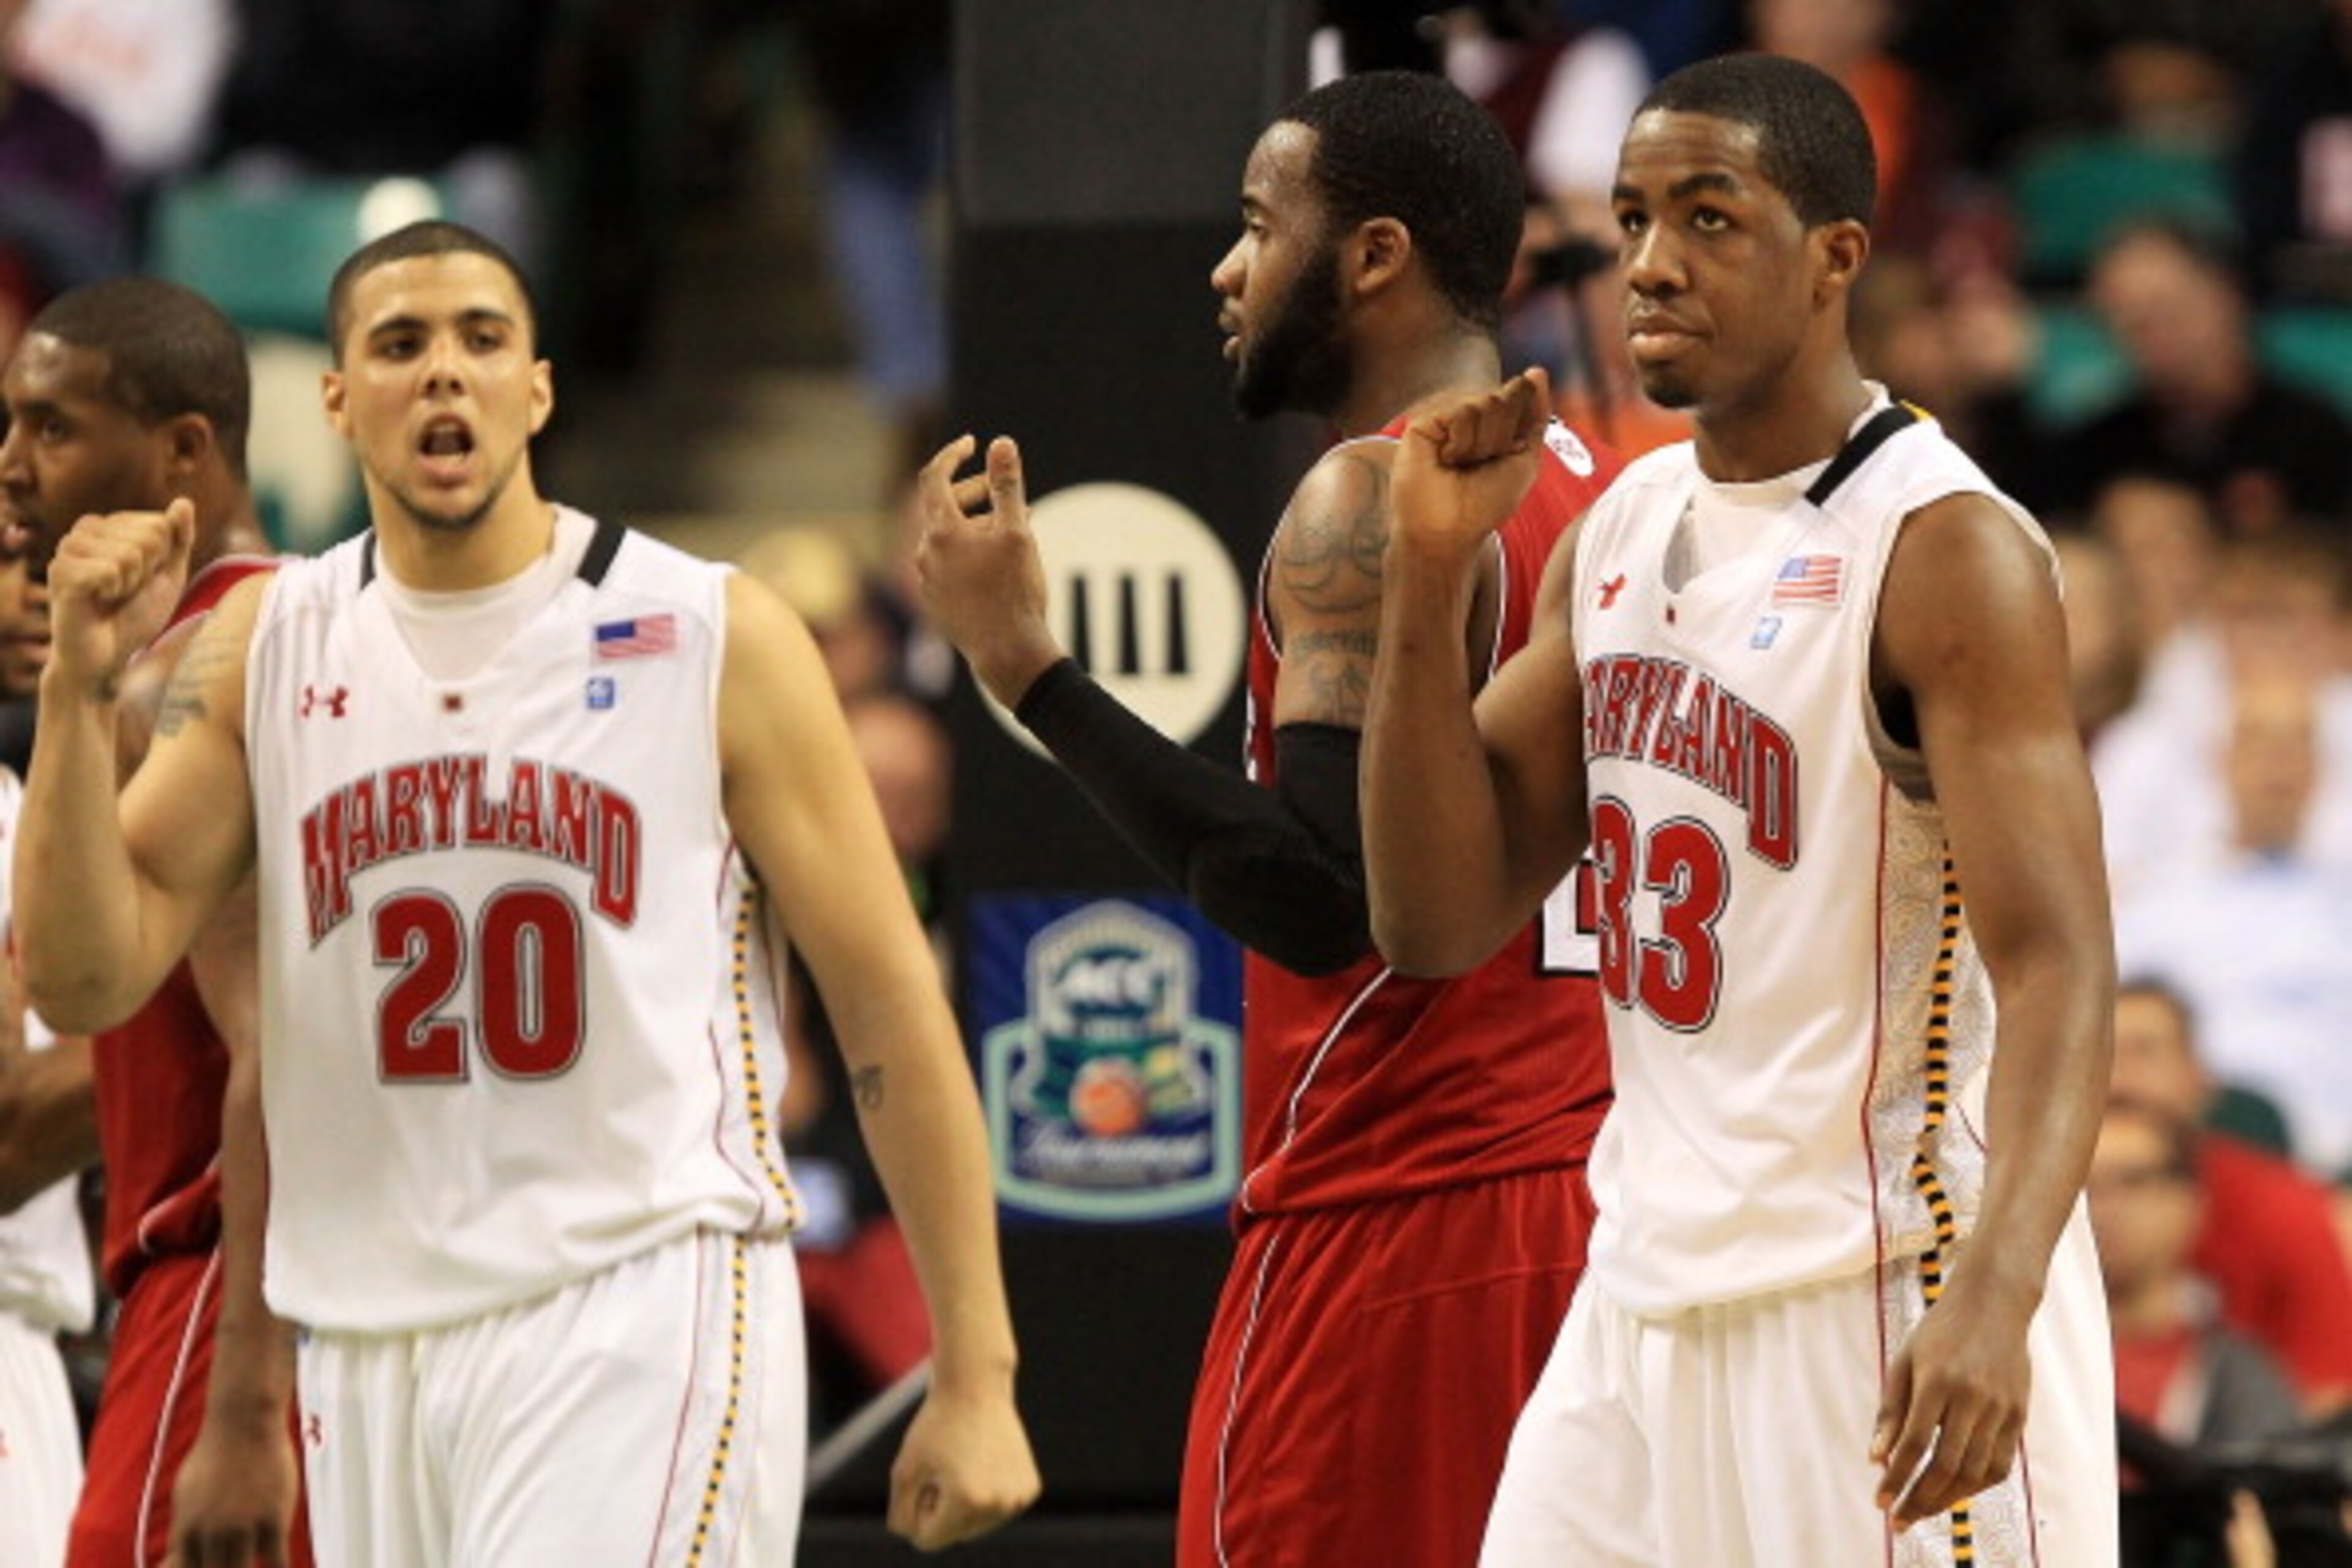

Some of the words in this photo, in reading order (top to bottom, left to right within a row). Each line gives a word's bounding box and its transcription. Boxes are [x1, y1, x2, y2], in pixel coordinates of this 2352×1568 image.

[300, 753, 641, 951] MARYLAND
[1585, 653, 1799, 871] ARYLAND
[369, 880, 586, 1085] 20
[1593, 794, 1731, 1035] 33
